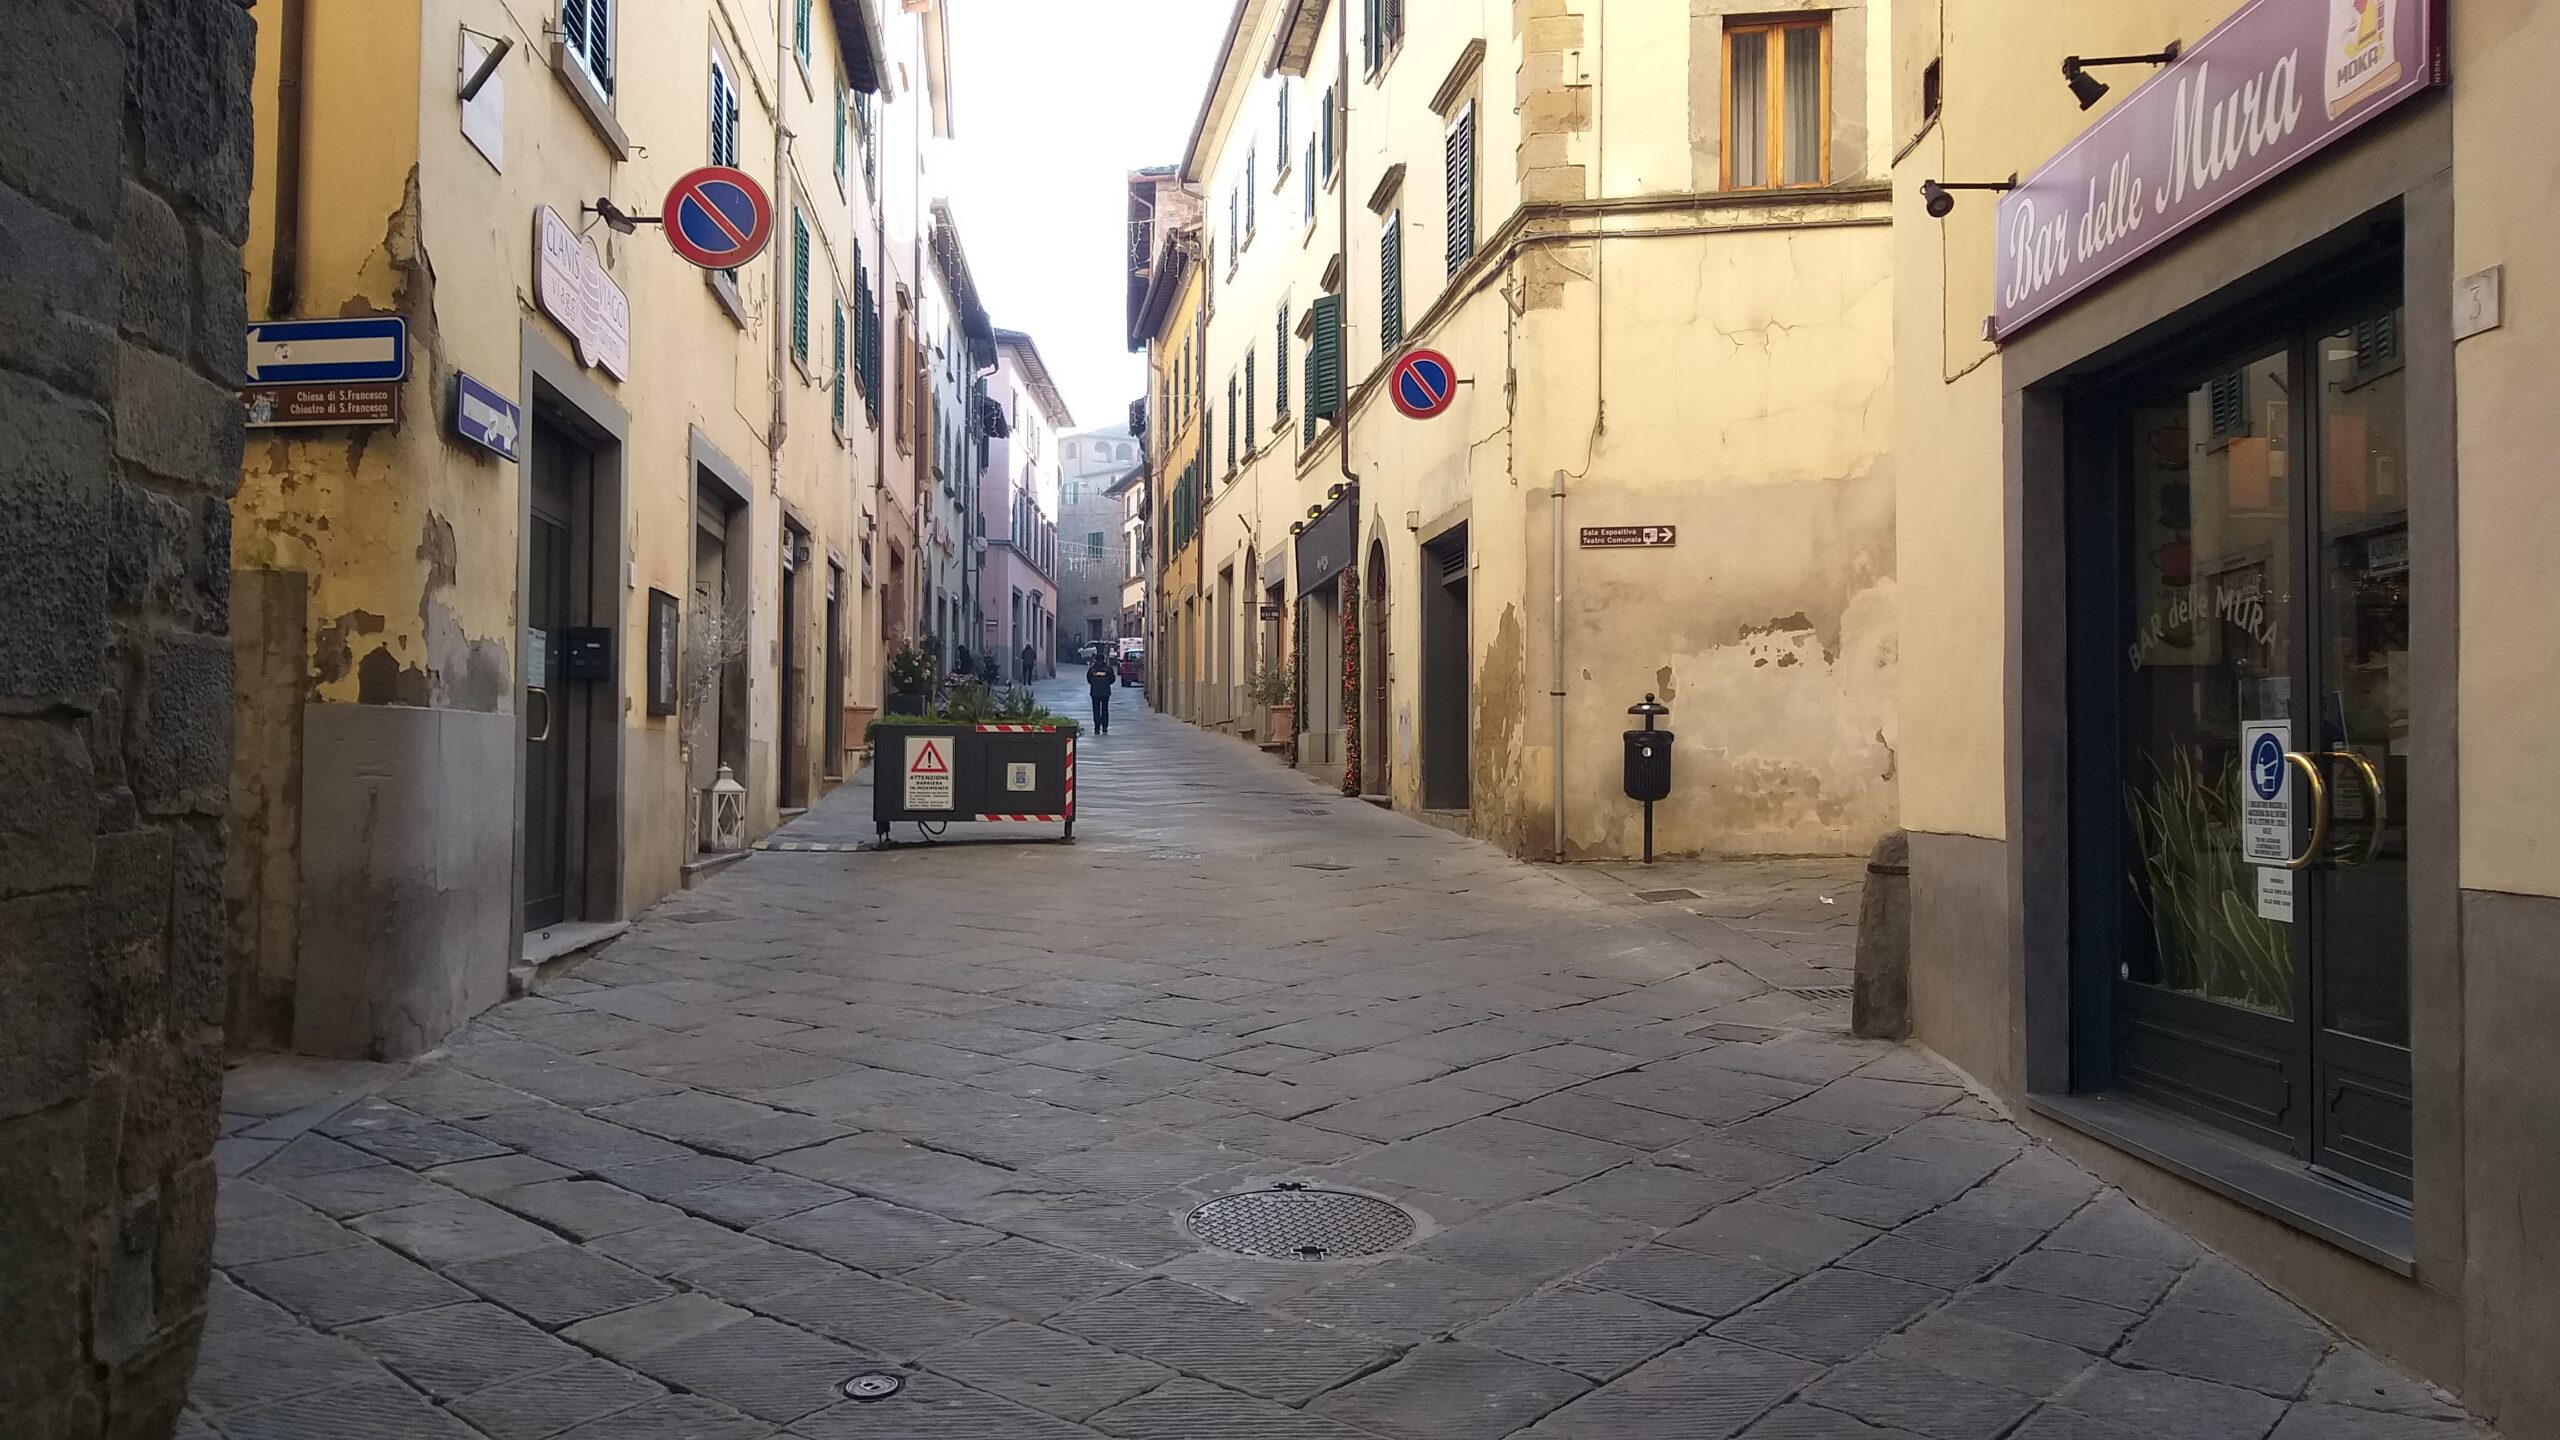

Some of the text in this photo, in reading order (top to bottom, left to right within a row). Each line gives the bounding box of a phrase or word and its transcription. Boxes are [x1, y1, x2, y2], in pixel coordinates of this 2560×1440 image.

[2337, 45, 2379, 88] MOKA
[2006, 47, 2302, 309] Bar delle Mura
[546, 221, 580, 280] CLANIS
[2469, 285, 2482, 320] 3
[290, 402, 388, 415] Chiostro di S.Francesco
[297, 389, 388, 402] Chiesa di S.Francesco
[1600, 528, 1637, 536] Espositiva
[1607, 536, 1641, 544] Comunale
[2128, 585, 2278, 673] BAR delle MURA
